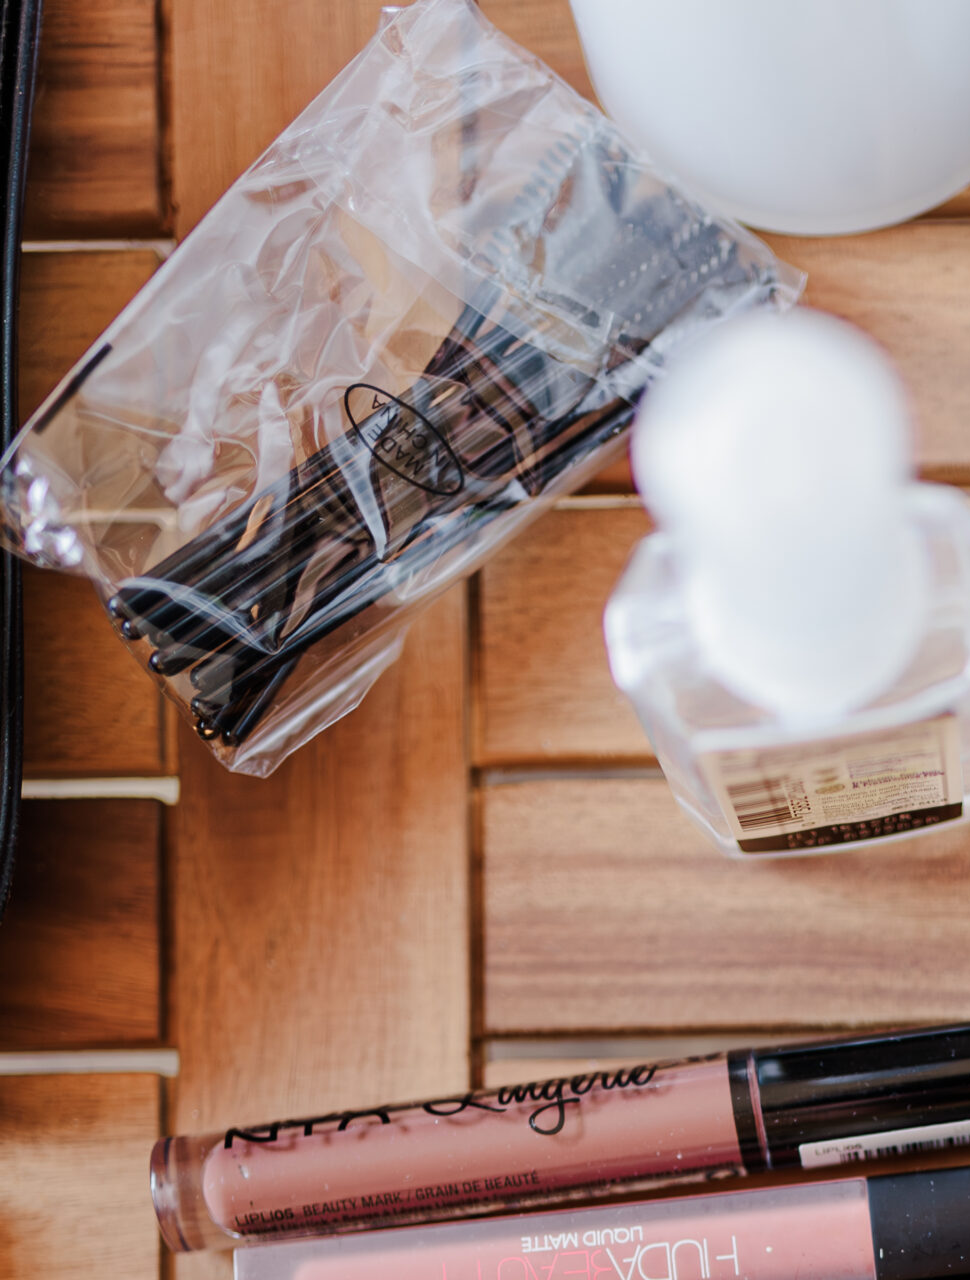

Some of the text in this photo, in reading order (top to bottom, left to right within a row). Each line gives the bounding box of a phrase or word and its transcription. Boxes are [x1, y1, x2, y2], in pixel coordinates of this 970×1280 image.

[372, 394, 428, 450] CHINA
[367, 423, 425, 475] MADE
[302, 1198, 357, 1218] BEAUTY
[360, 1190, 401, 1209] MARK
[414, 1180, 460, 1201] GRAIN
[462, 1178, 483, 1195] DE
[484, 1169, 542, 1193] BEAUTÉ
[521, 1226, 644, 1253] LIQUID MATTE
